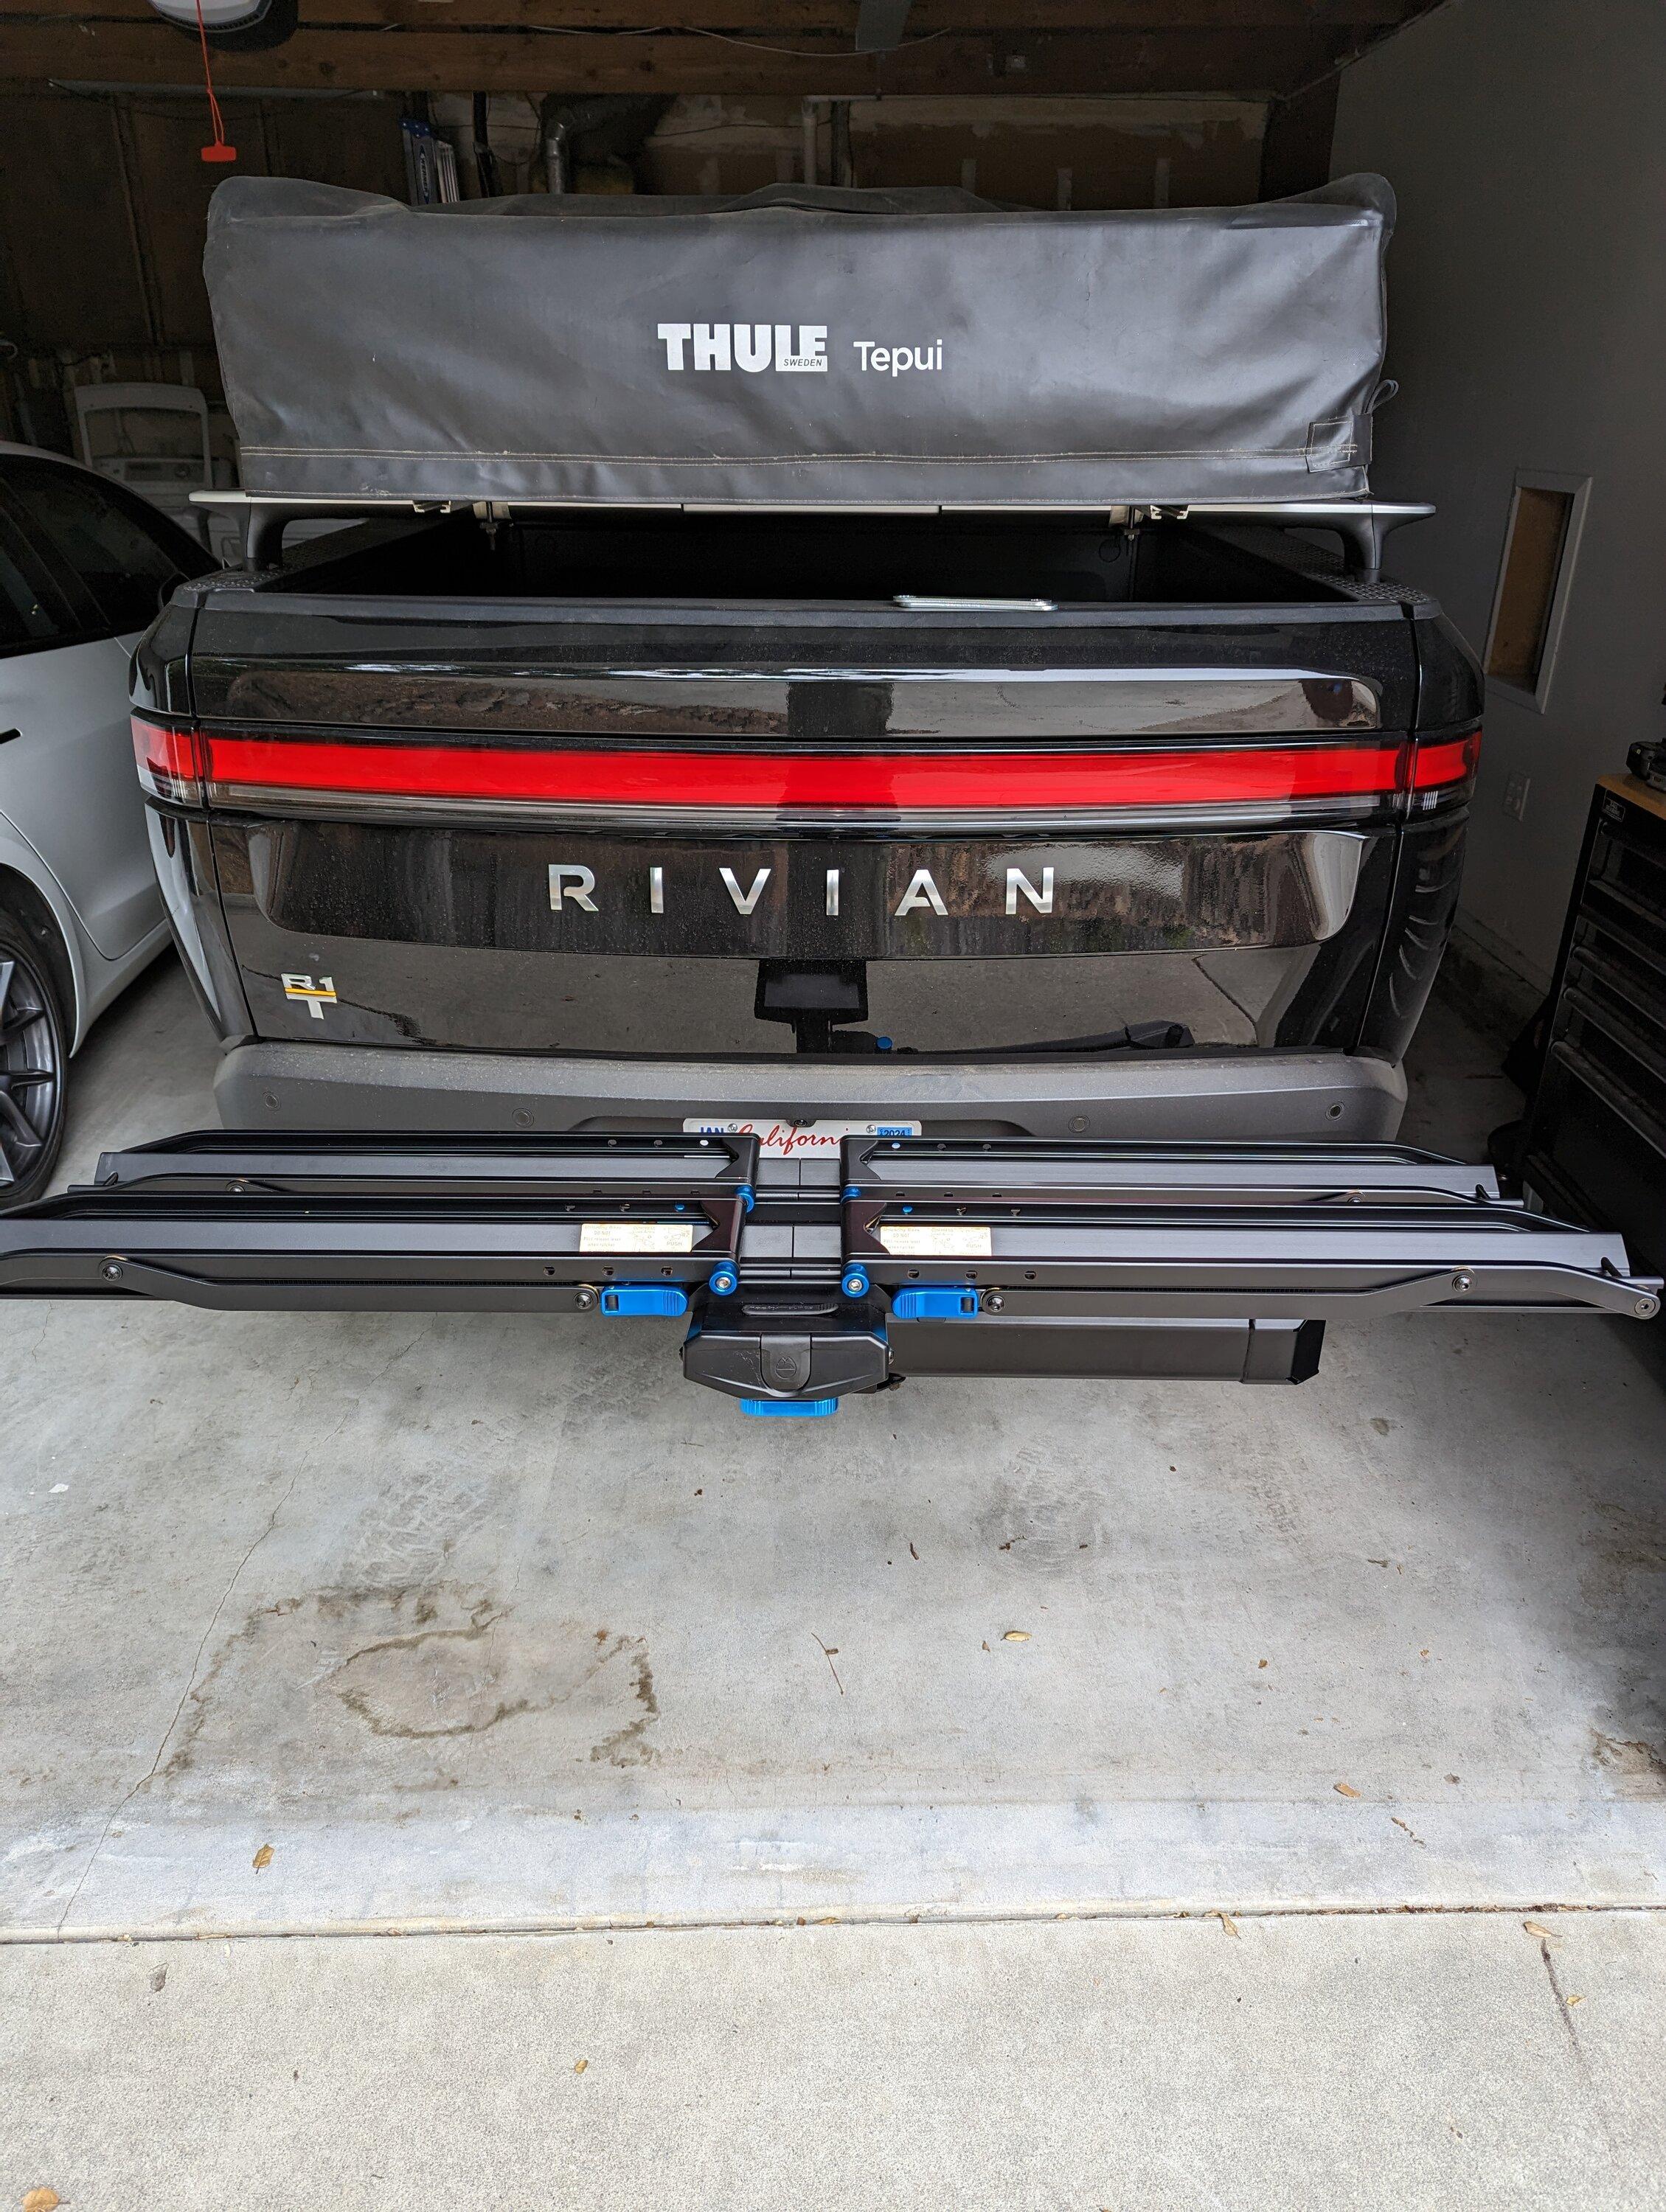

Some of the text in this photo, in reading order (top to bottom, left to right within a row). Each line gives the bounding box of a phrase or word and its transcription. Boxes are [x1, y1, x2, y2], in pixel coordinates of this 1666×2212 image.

[657, 323, 943, 378] THULE Tepui
[783, 358, 823, 368] SWEDEN
[548, 863, 1055, 916] RIVIAN
